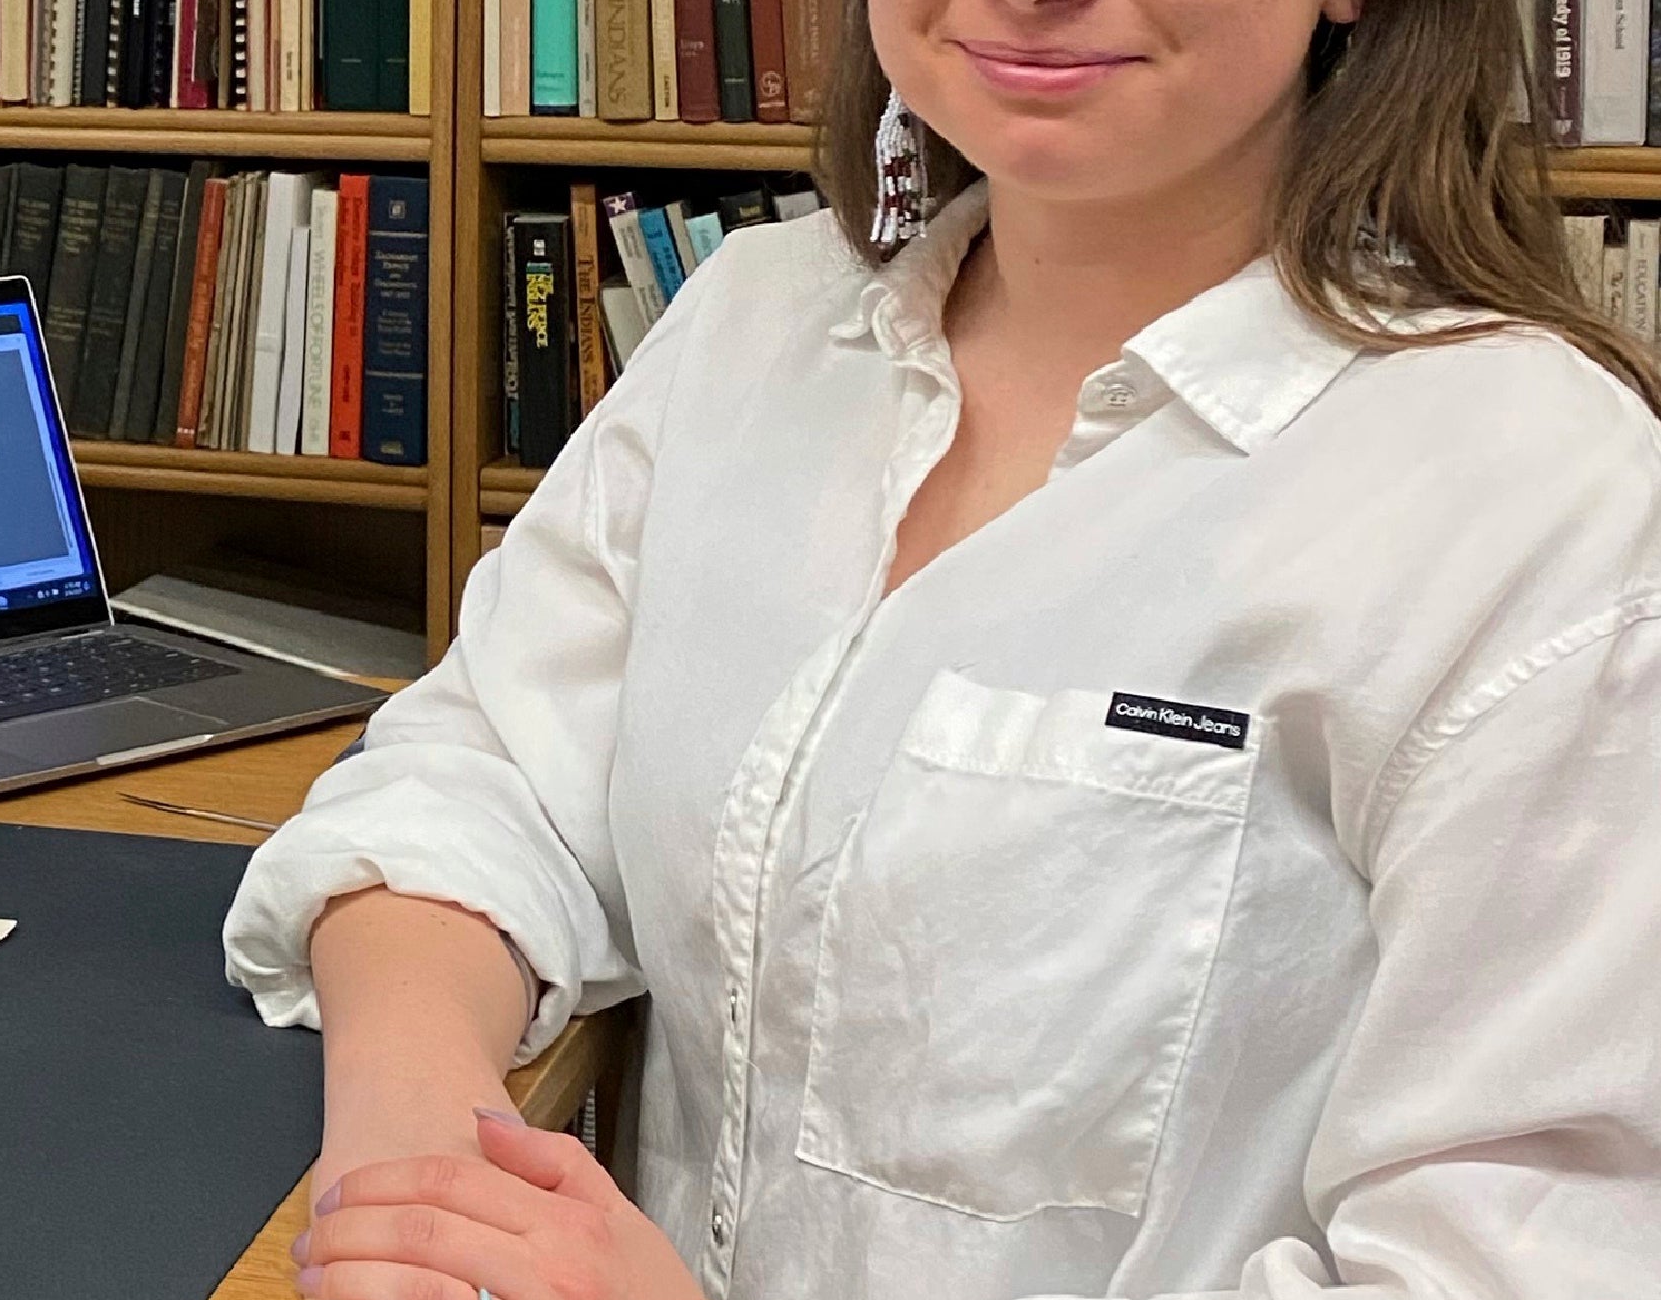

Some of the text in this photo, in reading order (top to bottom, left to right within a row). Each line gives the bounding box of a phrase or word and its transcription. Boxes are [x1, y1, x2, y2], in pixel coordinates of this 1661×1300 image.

[1556, 28, 1572, 43] of
[1615, 13, 1627, 50] School
[1556, 46, 1572, 78] 1919
[578, 255, 595, 363] THE INDIANS
[1634, 259, 1647, 331] EDUCATION
[1115, 703, 1241, 737] Calvin Klein Jeans
